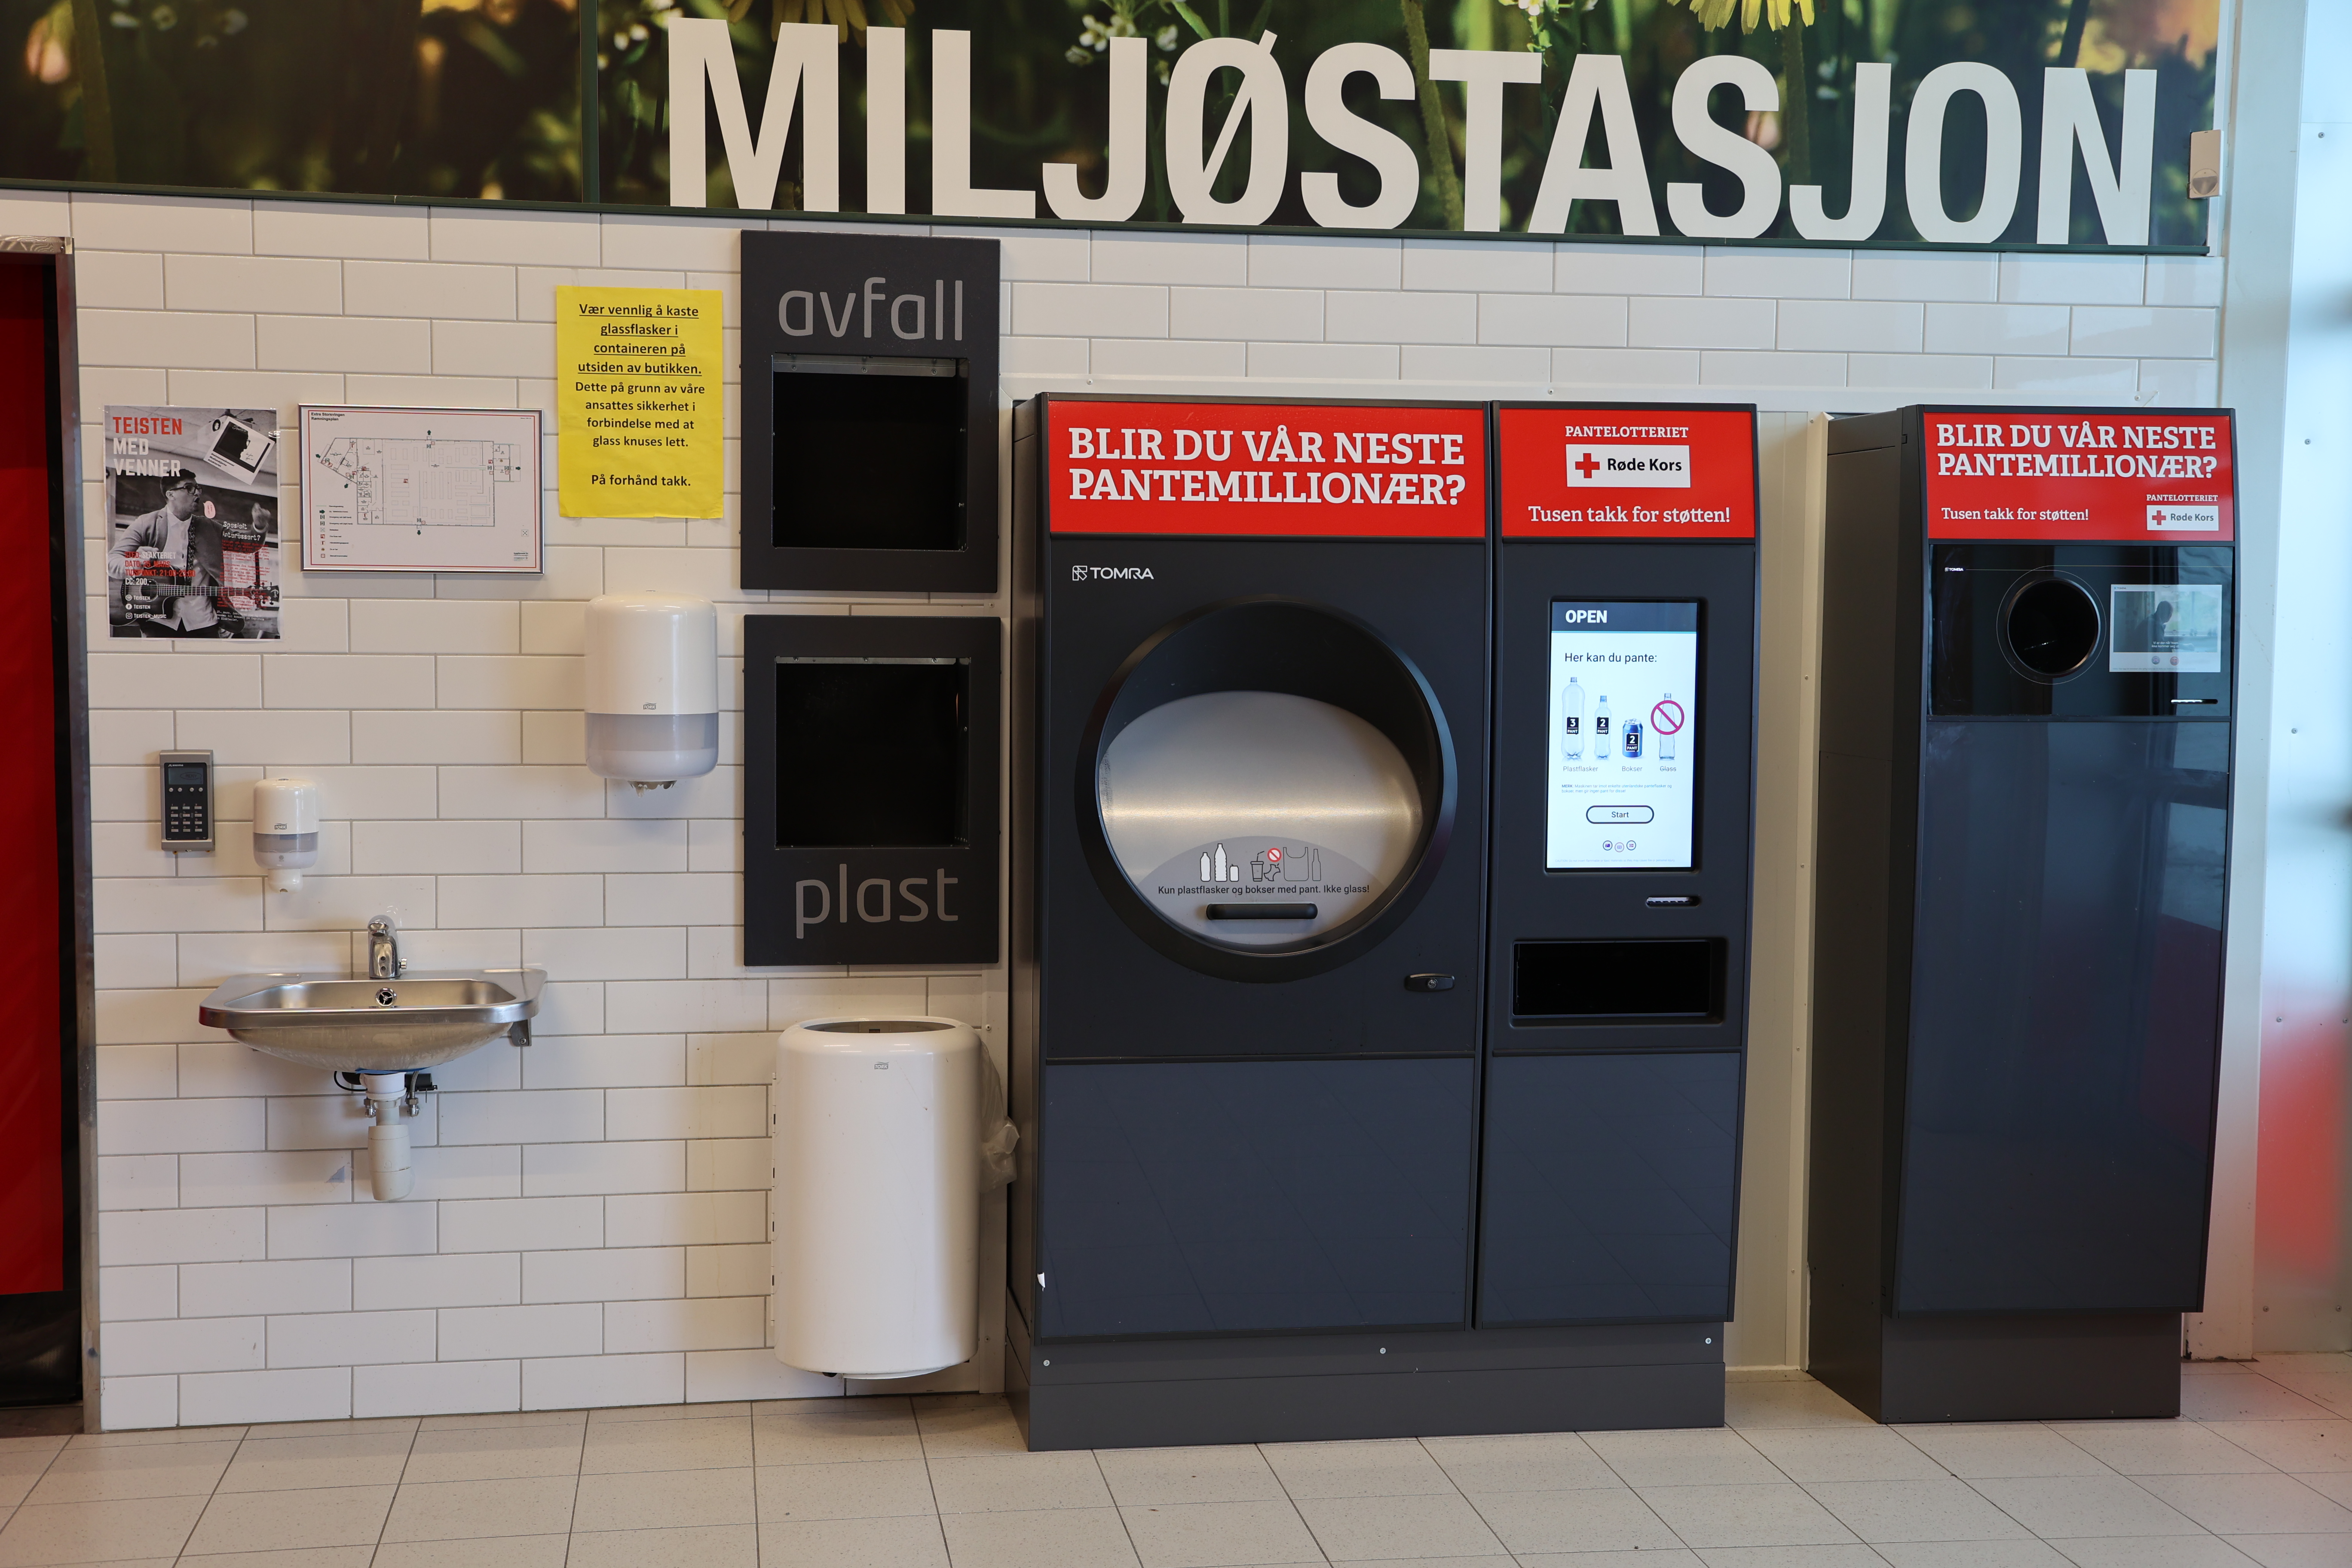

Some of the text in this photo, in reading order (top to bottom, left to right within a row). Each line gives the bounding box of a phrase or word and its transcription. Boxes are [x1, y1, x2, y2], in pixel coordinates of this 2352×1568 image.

[668, 18, 2157, 246] MILJØSTASJON
[579, 304, 699, 317] Vær vennlig å kaste
[779, 277, 962, 340] avfall
[601, 324, 678, 336] glassflasker i
[594, 343, 686, 356] containeren på
[578, 362, 623, 373] utsiden
[645, 364, 701, 374] butikken.
[576, 383, 607, 392] Dette
[611, 383, 624, 395] på
[628, 385, 660, 395] grunn
[680, 383, 705, 394] våre
[586, 401, 695, 411] ansattes sikkerhet i
[113, 417, 182, 435] TEISTEN
[587, 418, 694, 429] forbindelse med at
[1565, 426, 1688, 438] PANTELOTTERIET
[1937, 421, 2216, 449] BLIR DU VÅR NESTE
[113, 438, 148, 455] MED
[593, 437, 688, 447] glass knuses lett.
[1069, 425, 1464, 465] BLIR DU VÅR NESTE
[114, 459, 181, 477] VENNER
[1608, 458, 1682, 471] Røde Kors
[1938, 453, 2217, 478] PANTEMILLIONÆR?
[592, 475, 691, 486] På forhånd takk.
[1069, 469, 1465, 505] PANTEMILLIONÆR?
[1528, 506, 1730, 524] Tusen takk for støtten!
[1942, 508, 2089, 521] Tusen takk for støtten!
[2171, 513, 2214, 522] Røde Kors
[1090, 567, 1154, 579] TOMRA
[1565, 610, 1607, 623] OPEN
[1565, 653, 1657, 664] Her kan du pante:
[1629, 735, 1635, 744] 2
[1178, 886, 1229, 895] plastflasker
[1232, 888, 1243, 896] og
[1299, 887, 1321, 895] pant.
[1344, 885, 1369, 894] glass!
[796, 864, 958, 939] plast
